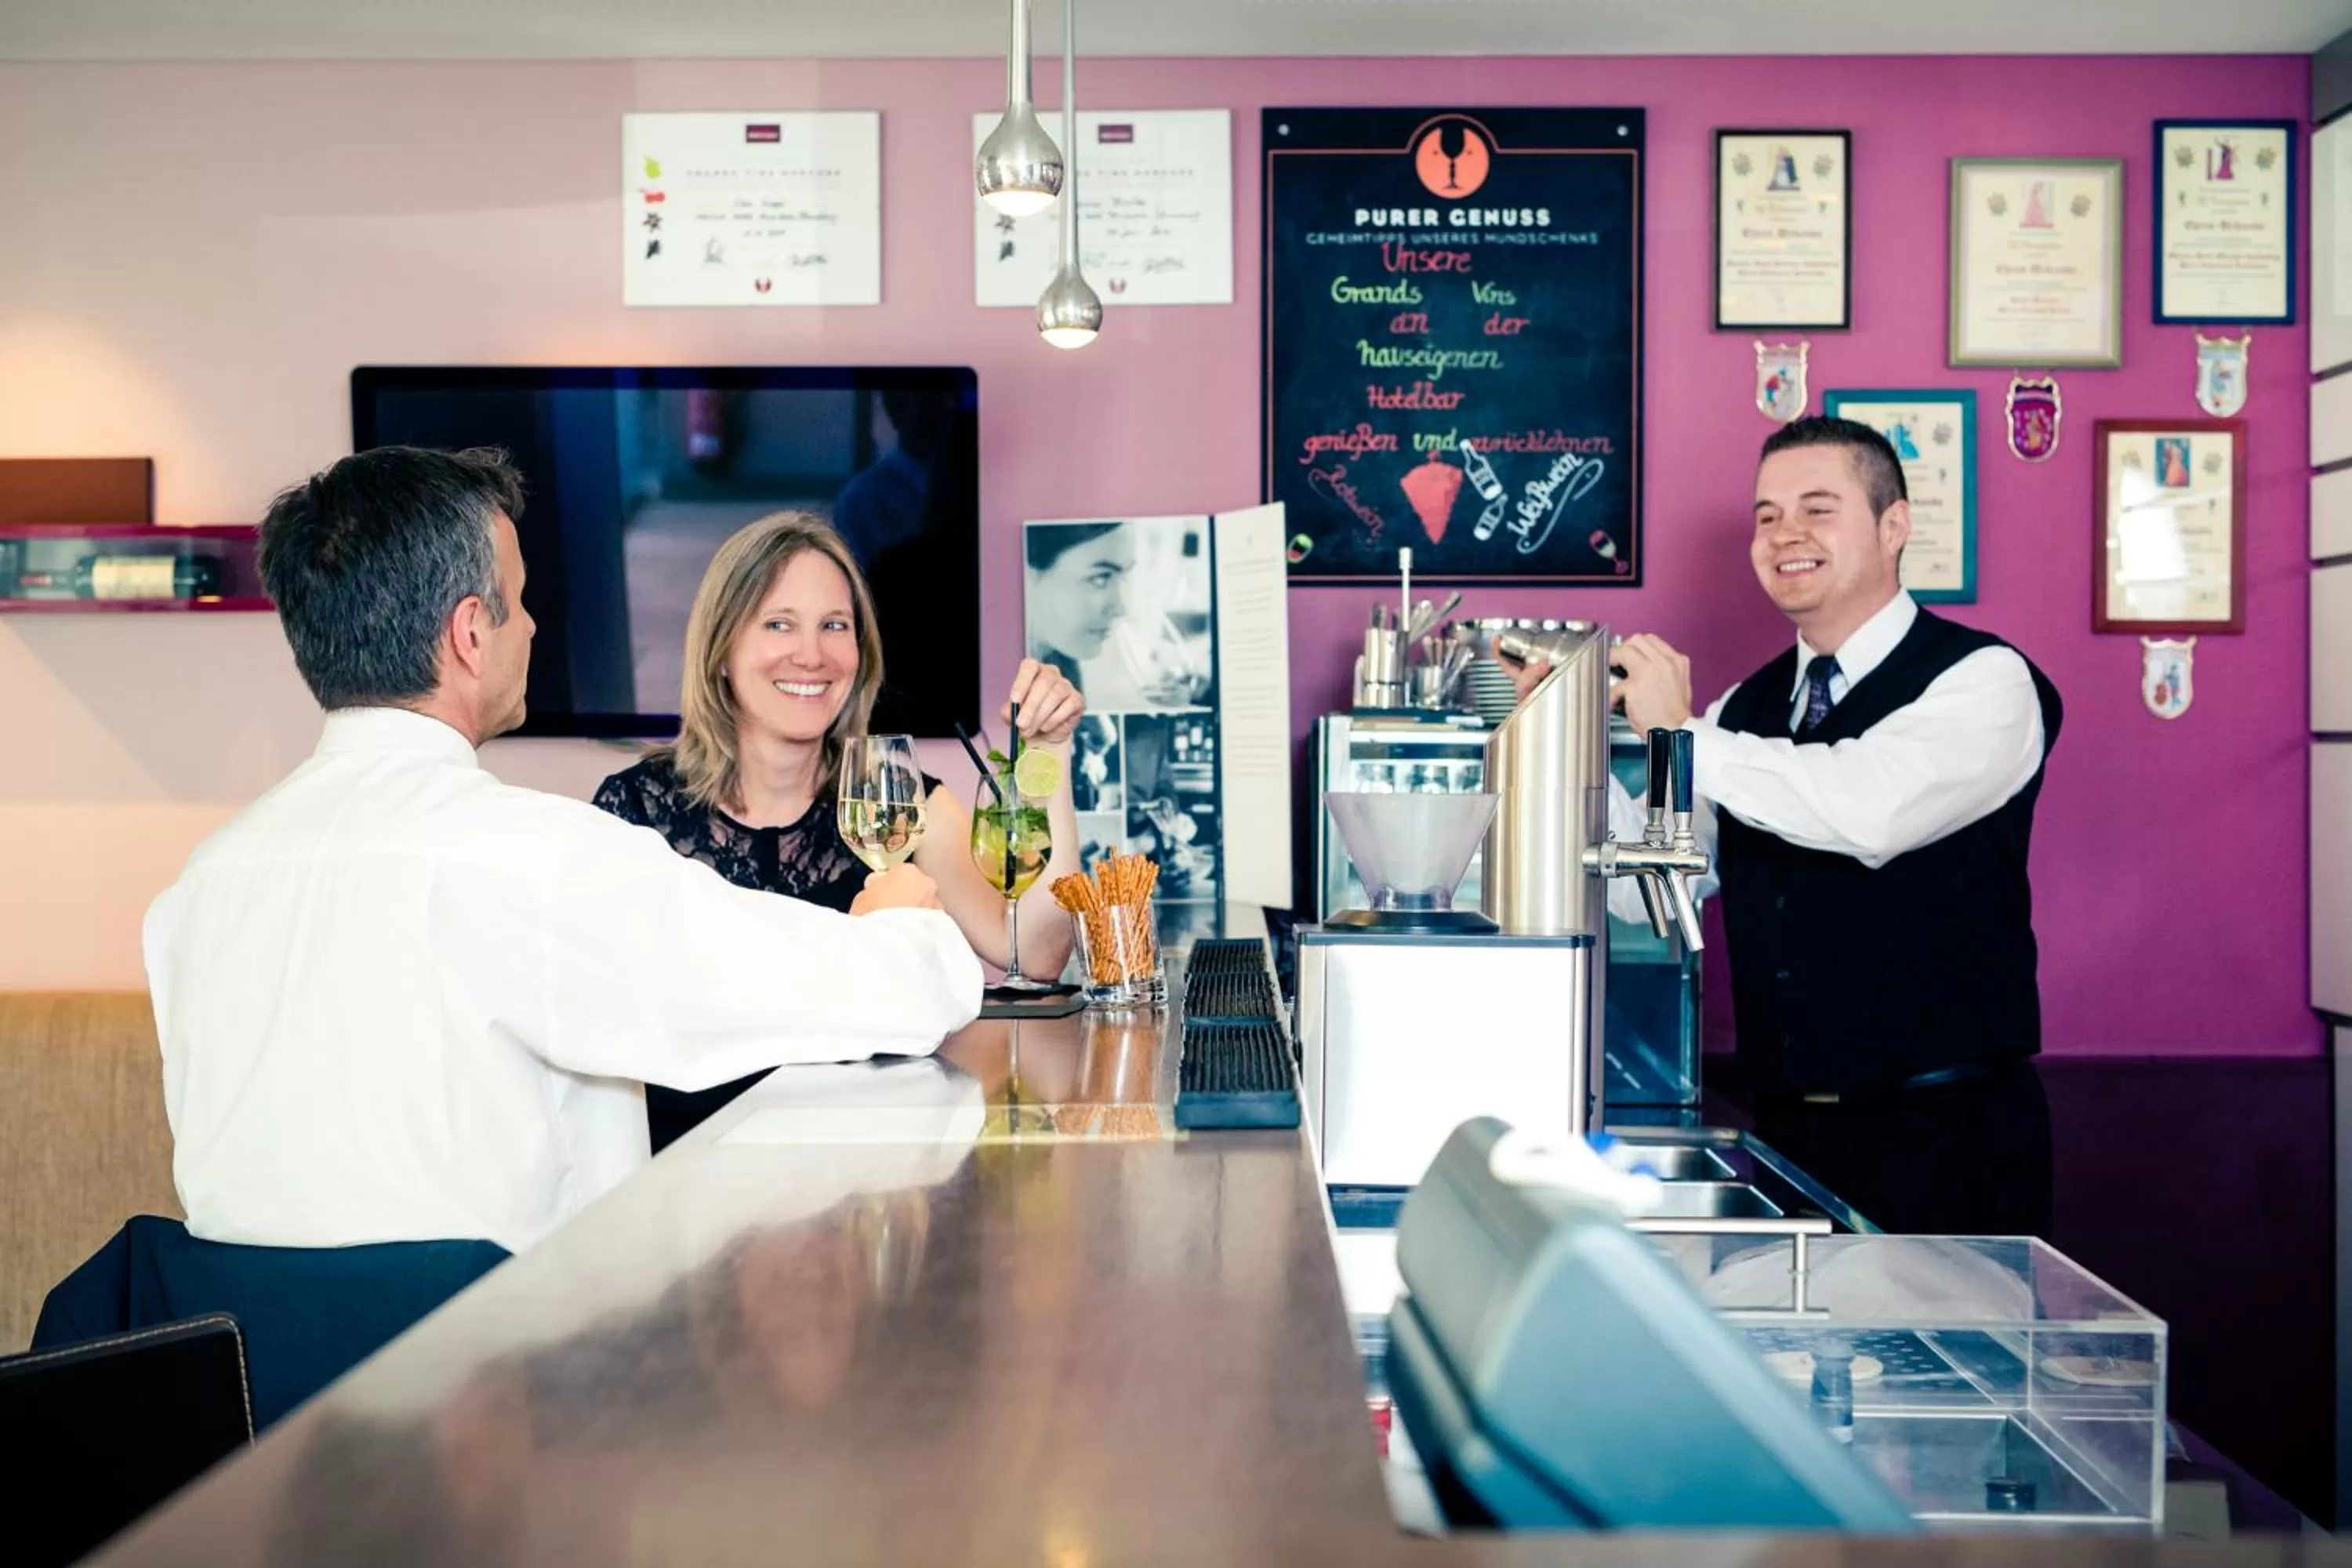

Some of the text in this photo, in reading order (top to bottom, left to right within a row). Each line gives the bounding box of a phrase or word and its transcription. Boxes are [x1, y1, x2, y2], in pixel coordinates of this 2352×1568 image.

[1354, 208, 1552, 227] PURER GENUSS
[1411, 231, 1480, 245] UNSERES
[1485, 232, 1599, 245] MUNDSCHENKS
[1381, 241, 1472, 273] Unsere
[1331, 275, 1424, 304] Grands
[1389, 311, 1531, 335] an der
[1356, 338, 1504, 380] hauseigenen
[1367, 380, 1465, 409] Hotelbar
[1298, 422, 1399, 464] genießen
[1413, 426, 1460, 452] und
